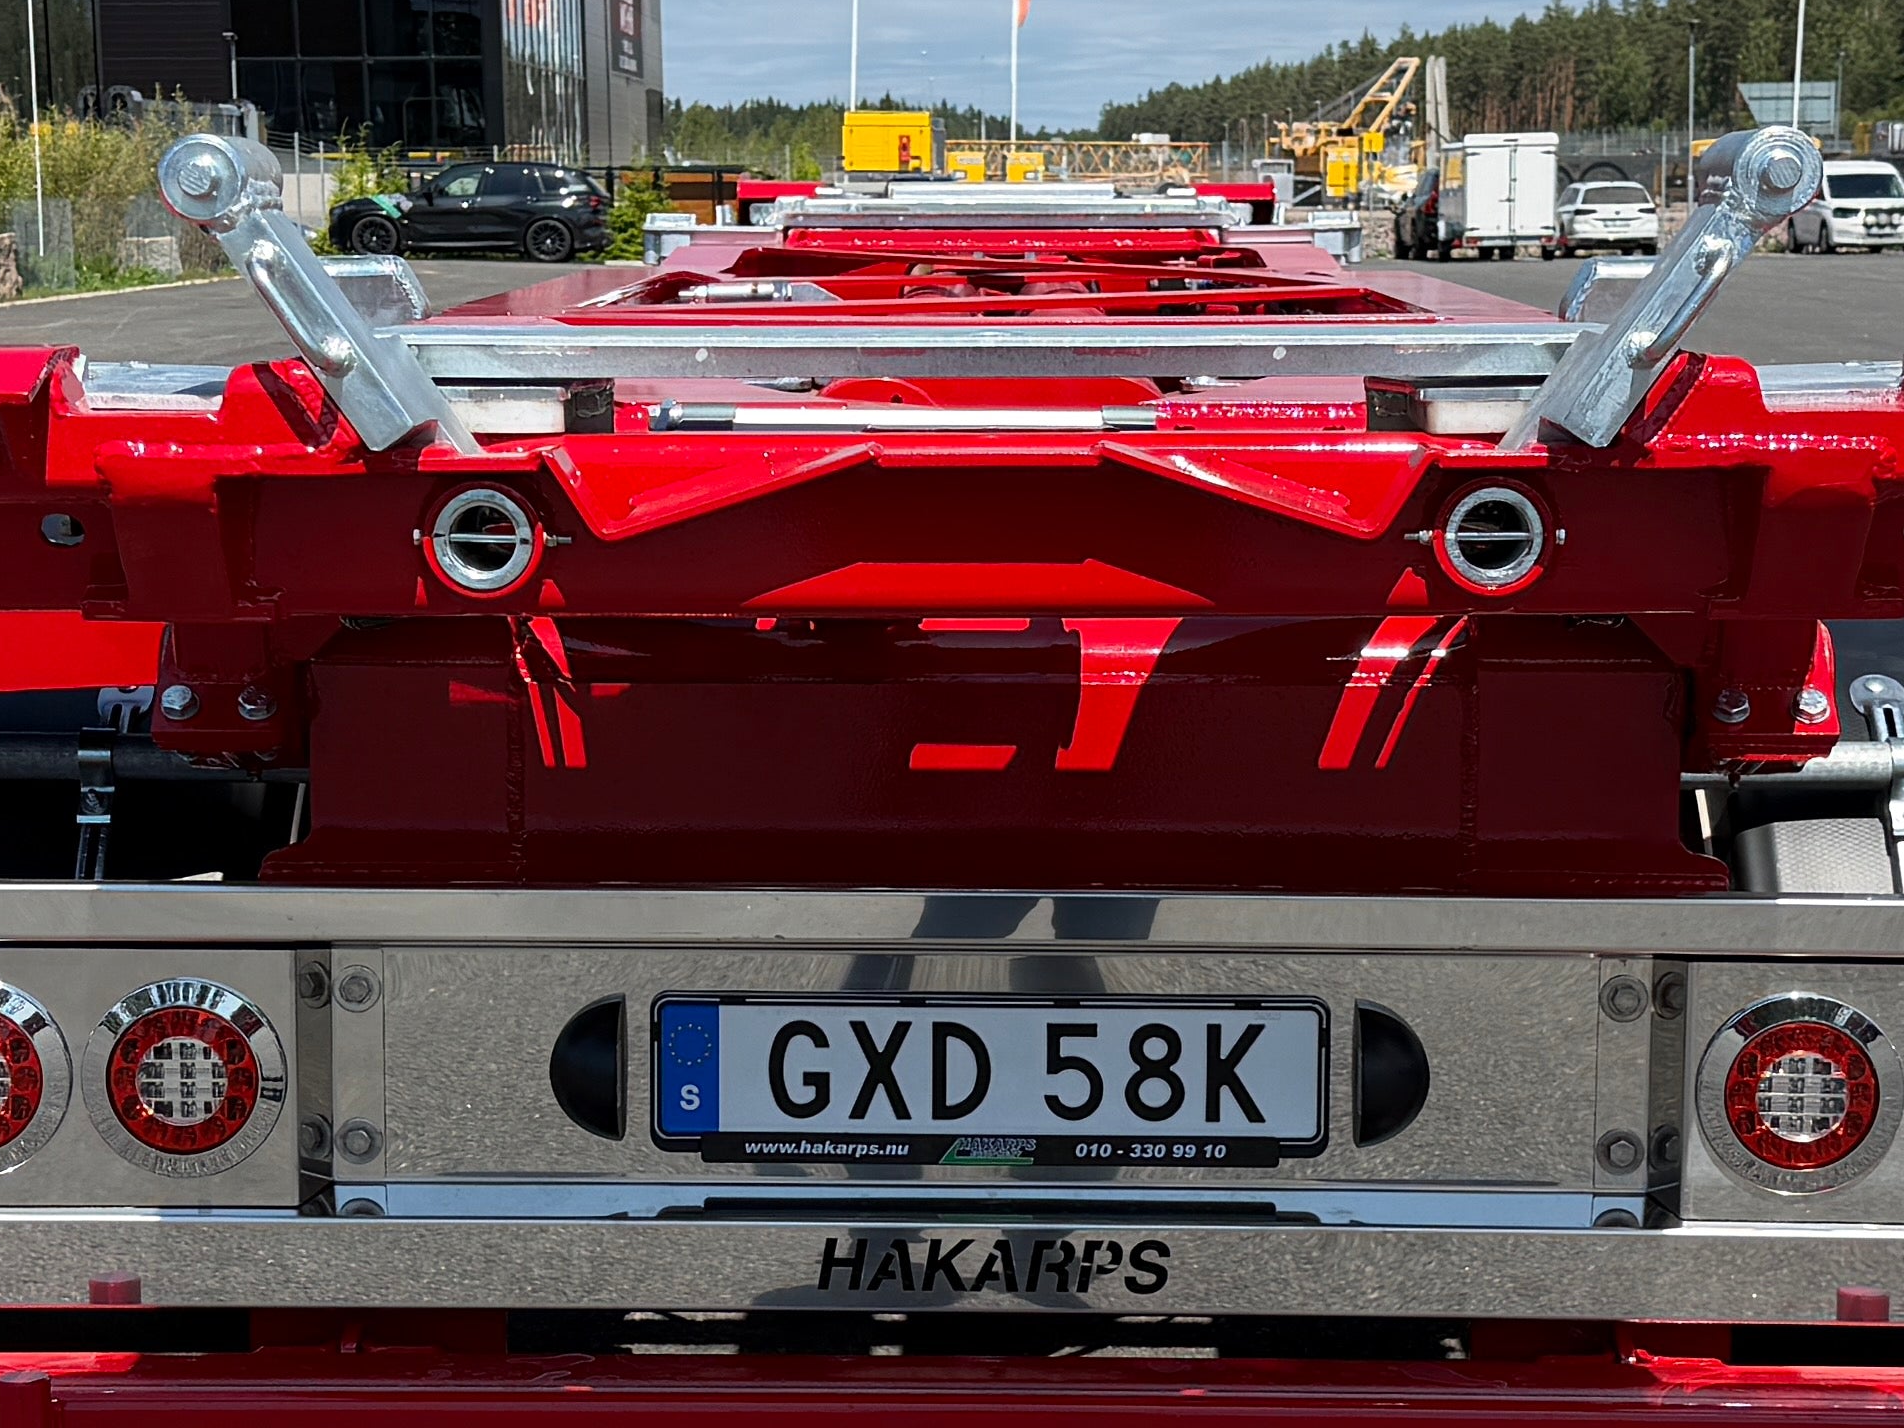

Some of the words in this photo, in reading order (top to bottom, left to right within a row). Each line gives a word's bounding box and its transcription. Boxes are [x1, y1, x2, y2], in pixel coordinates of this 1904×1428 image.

[767, 1020, 992, 1121] GXD
[1042, 1021, 1267, 1125] 58K
[679, 1083, 701, 1111] S
[744, 1138, 910, 1159] www.hakarps.nu
[1075, 1143, 1111, 1159] 010
[1128, 1144, 1166, 1160] 330
[1172, 1144, 1196, 1160] 99
[1202, 1144, 1227, 1160] 10
[815, 1236, 1172, 1297] HAKARPS
